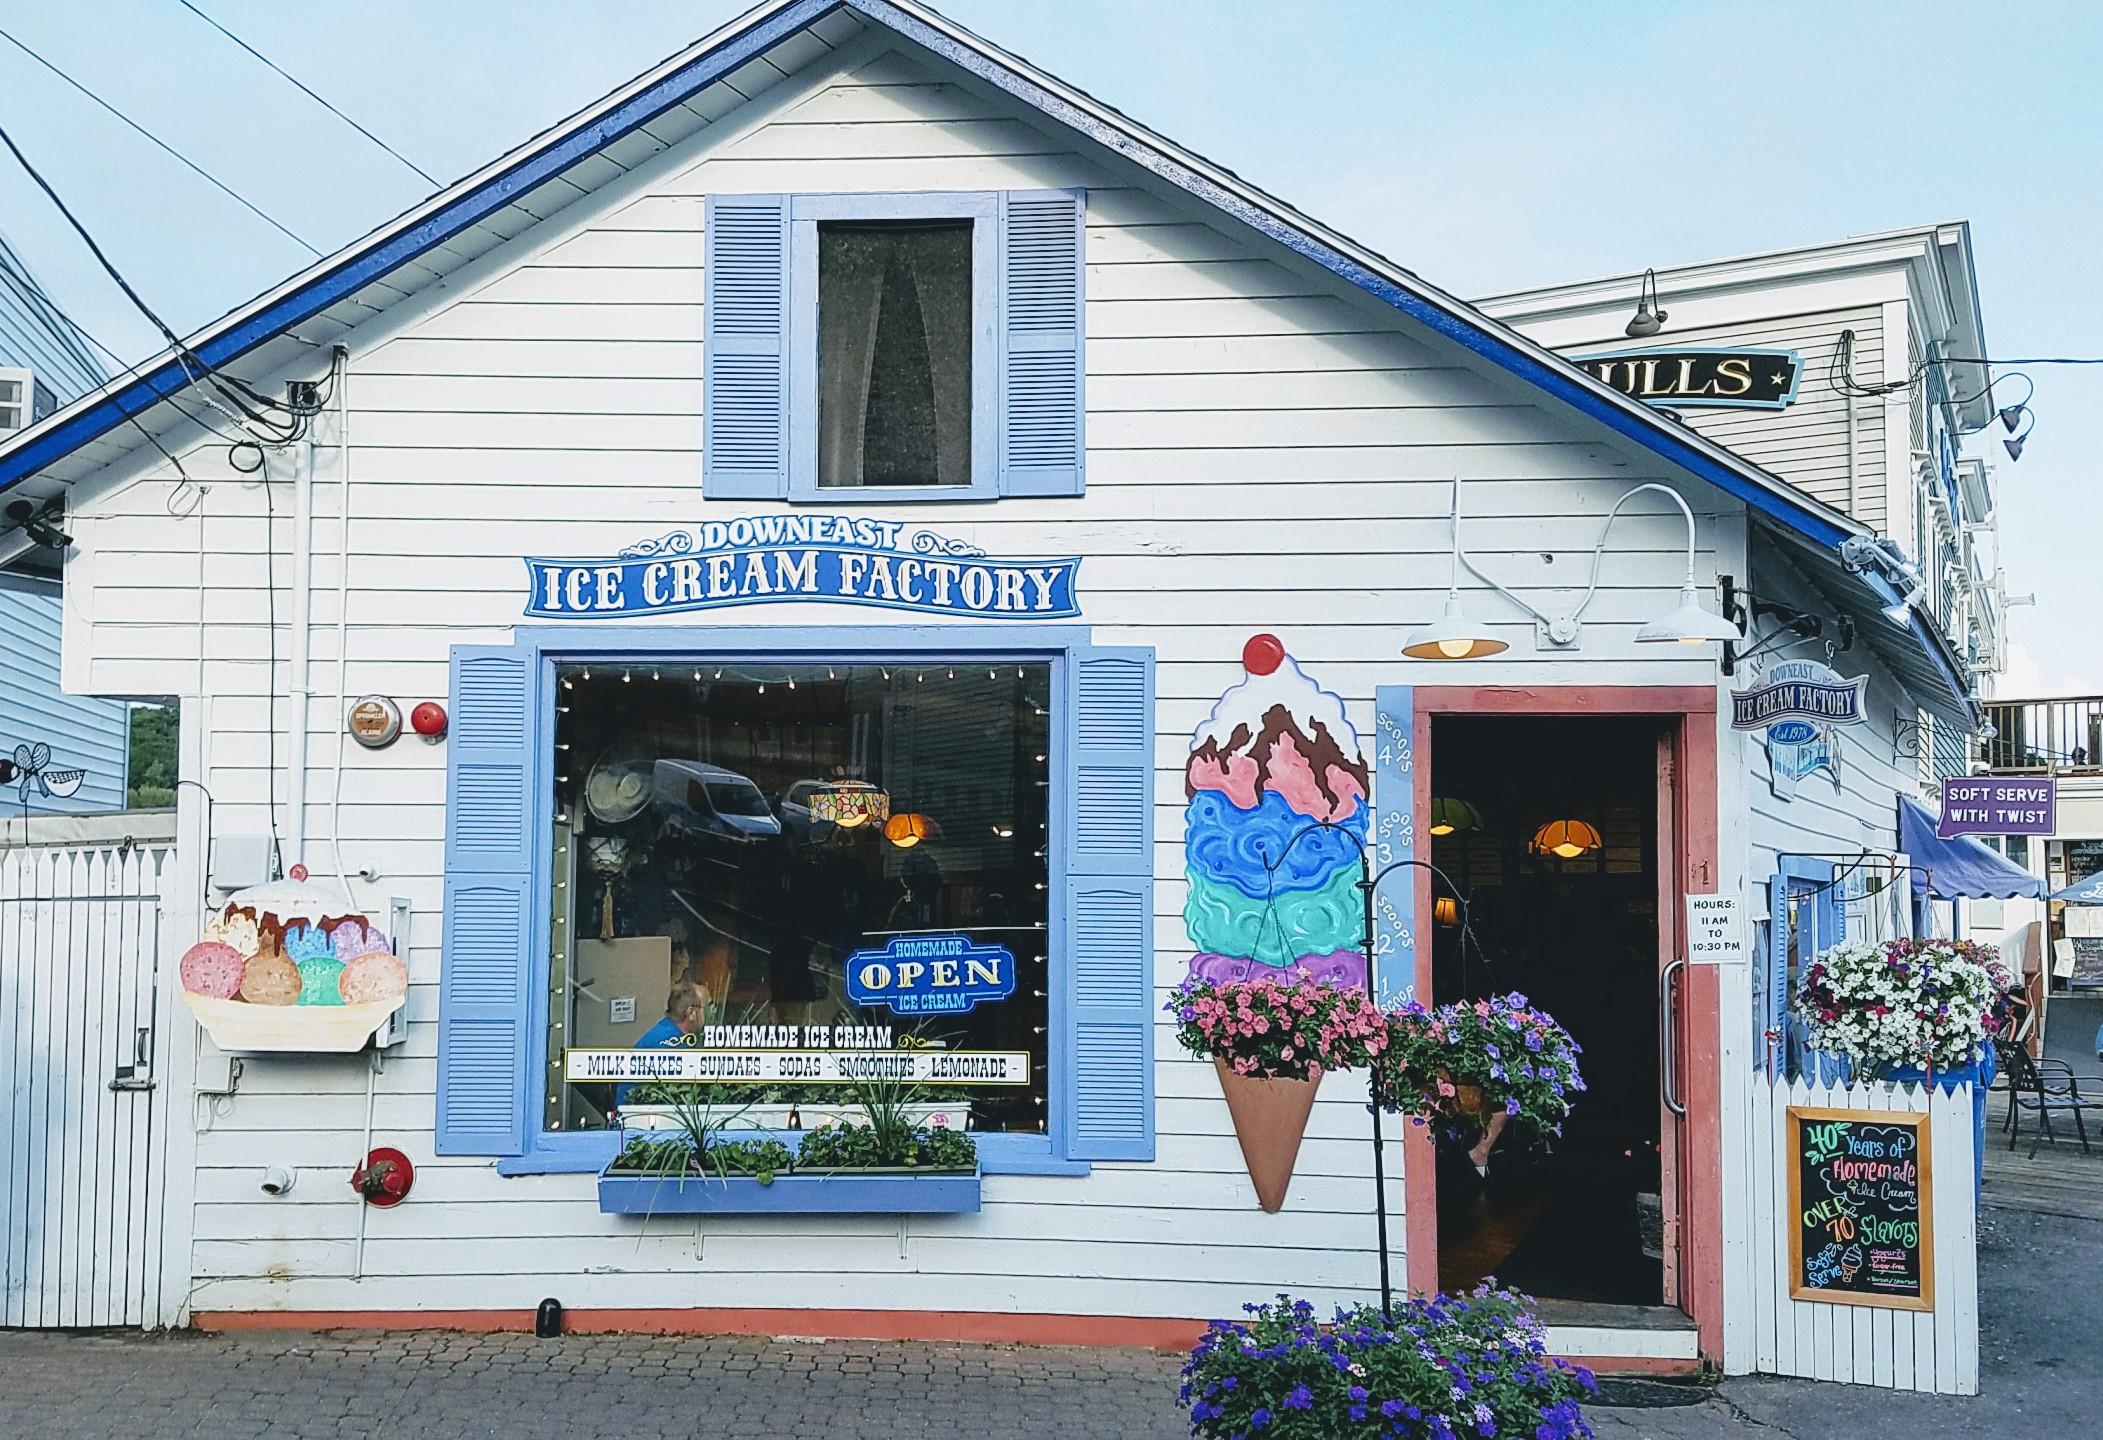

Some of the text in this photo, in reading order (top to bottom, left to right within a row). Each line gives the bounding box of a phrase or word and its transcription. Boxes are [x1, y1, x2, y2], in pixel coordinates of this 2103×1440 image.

[1583, 357, 1752, 396] ULLS
[701, 515, 903, 549] DOWNEAST
[543, 551, 1062, 611] ICE CREAM FACTORY
[1769, 663, 1814, 684] DOWNEAST
[1737, 686, 1854, 721] ICE CREAM FACTORY
[1377, 712, 1413, 772] SCOOPS
[1378, 744, 1392, 766] 4
[1949, 787, 2048, 802] SOFT SERVE
[1950, 808, 2047, 824] WITH TWIST
[1379, 811, 1413, 846] SCOOPS
[1379, 843, 1393, 864] 3
[1694, 900, 1736, 910] HOURS:
[1378, 896, 1414, 948] SCOOPS
[1701, 916, 1728, 925] 11 AM
[1379, 933, 1395, 955] 2
[1708, 929, 1722, 938] TO
[895, 941, 962, 958] HOMEMADE
[1693, 941, 1740, 951] 10:30 PM
[859, 959, 1002, 990] OPEN
[1382, 976, 1390, 997] 1
[899, 993, 966, 1011] ICE CREAM
[703, 1025, 892, 1048] HOMEMADE ICE CREAM
[587, 1055, 1007, 1078] MILK SHAKES SUNDAES SODAS SMOOTHIES LEMONADE
[1806, 1124, 1838, 1154] 40
[1846, 1135, 1906, 1158] Years of
[1833, 1156, 1916, 1187] Homemade
[1857, 1181, 1917, 1204] Ice Cream
[1803, 1196, 1849, 1228] OVER
[1825, 1216, 1855, 1242] 70
[1808, 1265, 1843, 1289] Serve
